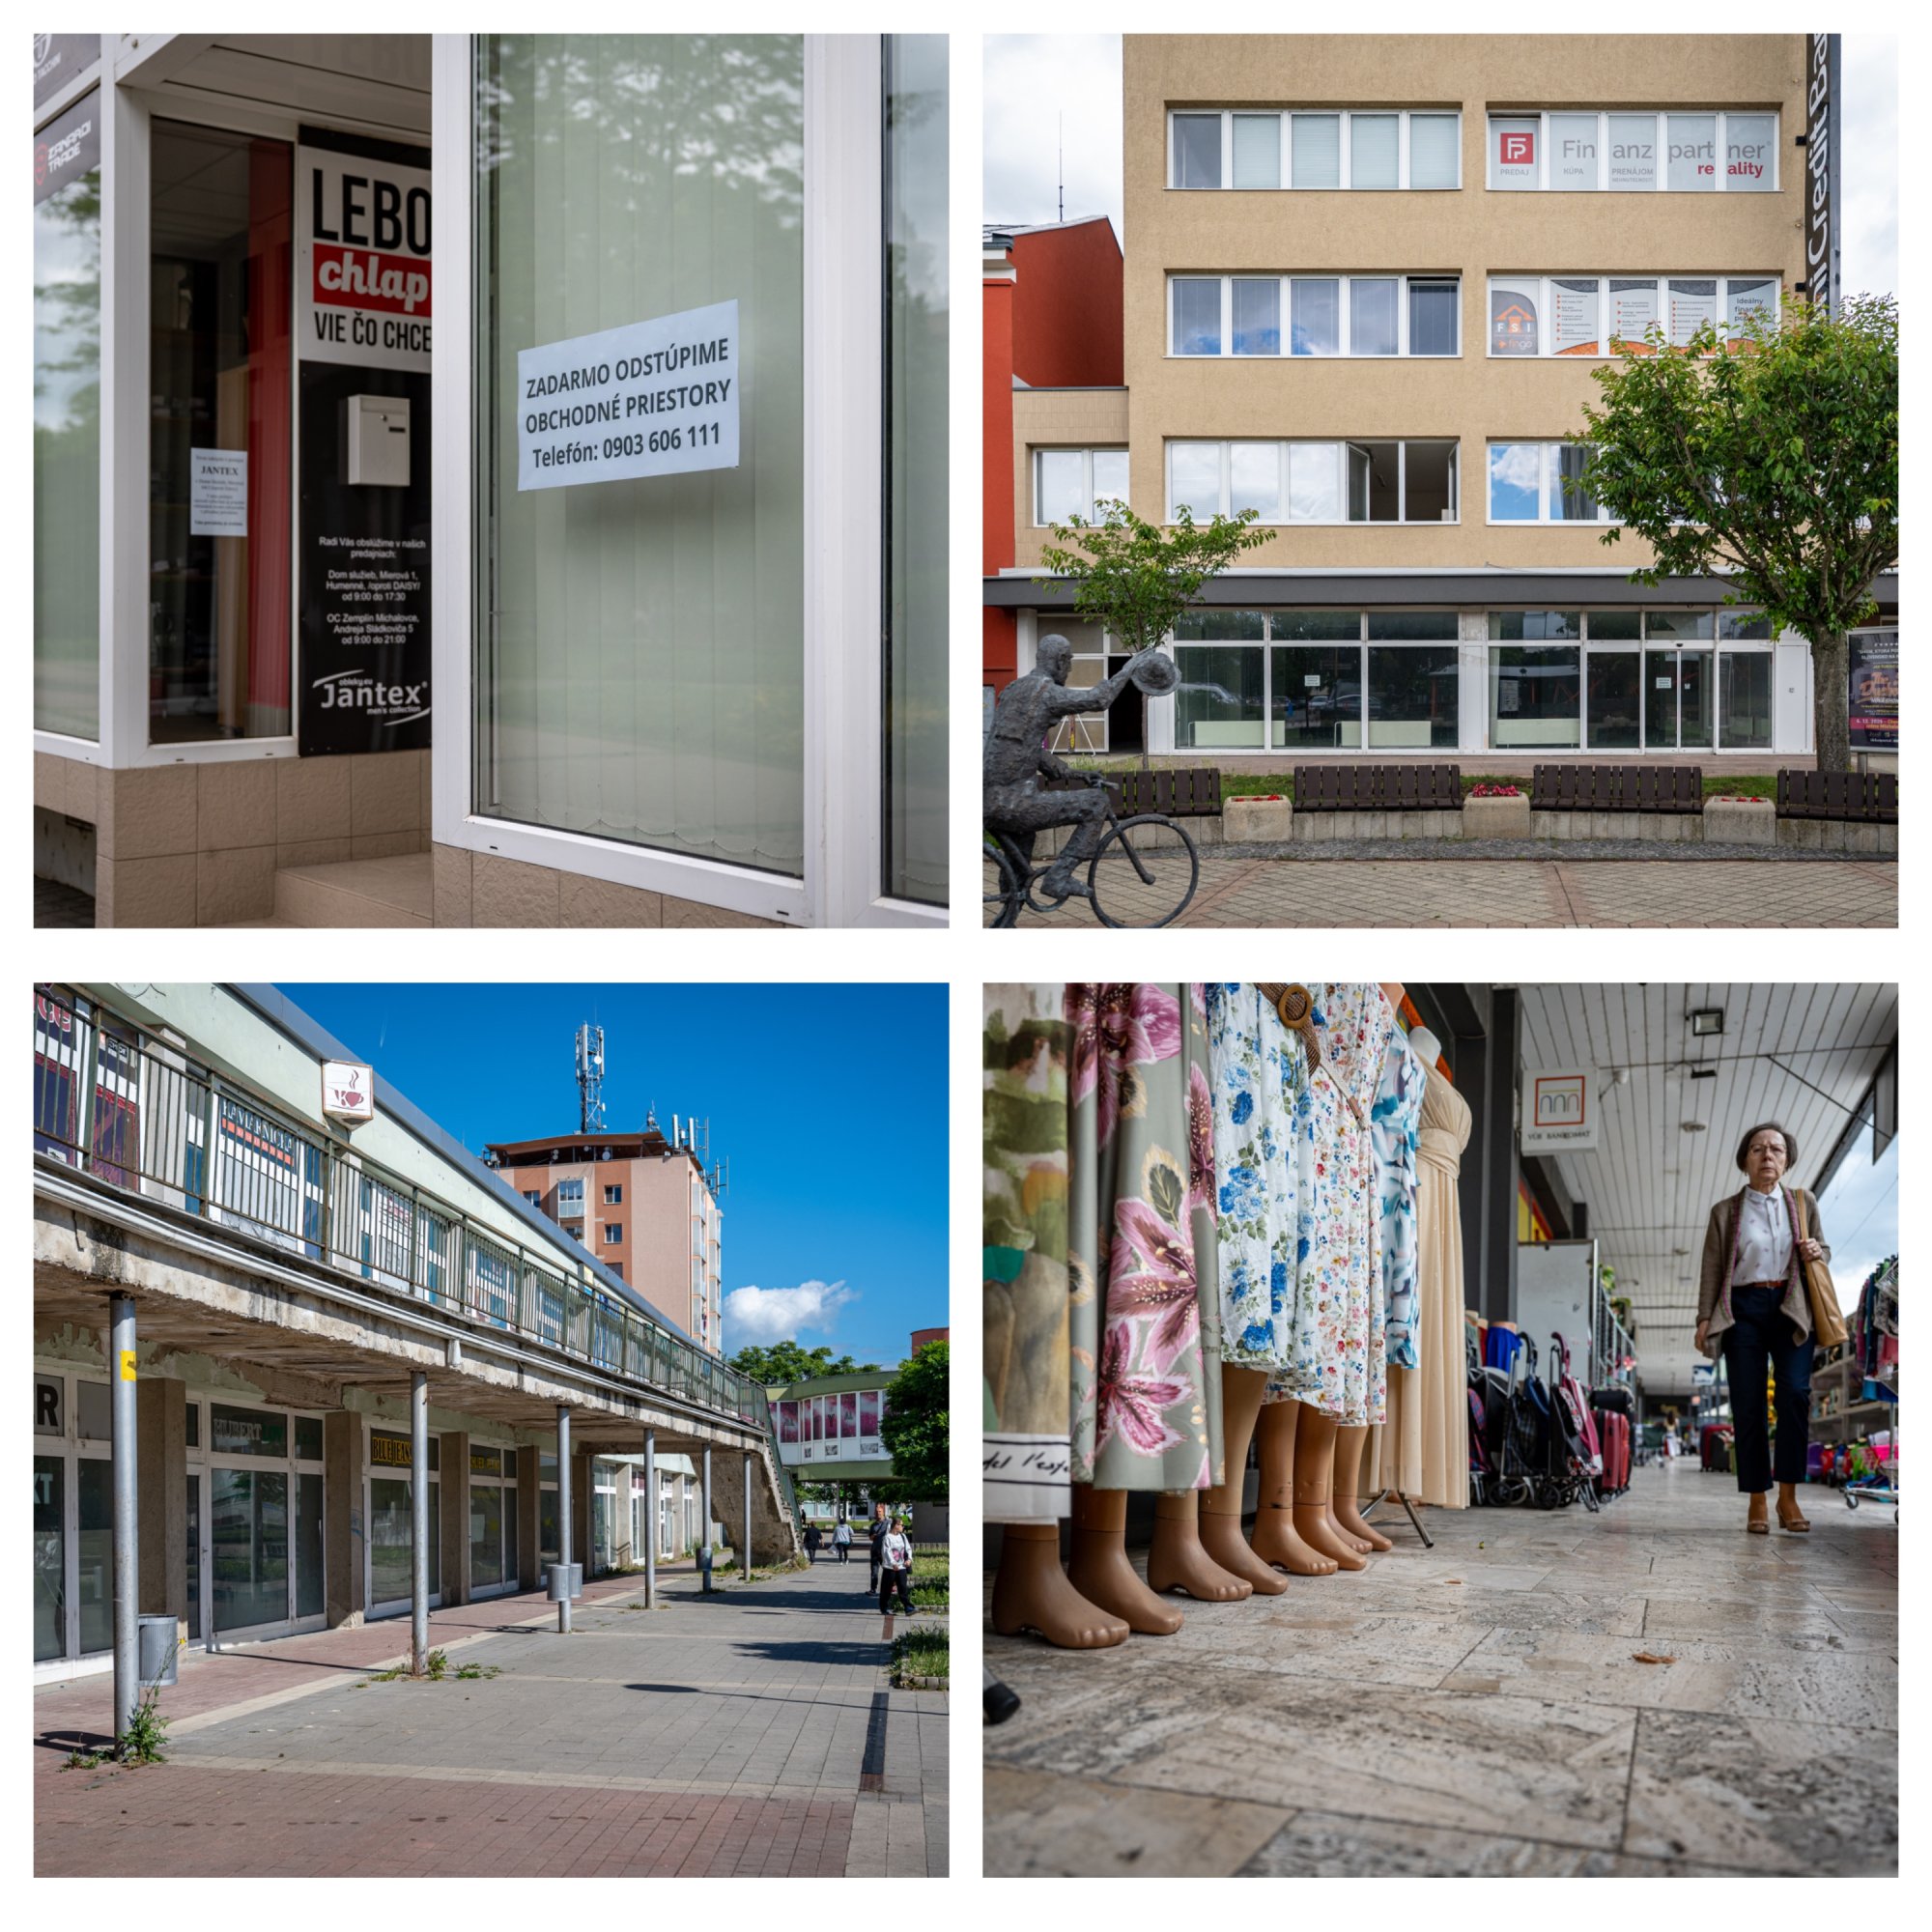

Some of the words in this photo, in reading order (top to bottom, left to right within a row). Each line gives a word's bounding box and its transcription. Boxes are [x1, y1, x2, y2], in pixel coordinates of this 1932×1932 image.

[48, 120, 92, 159] ZANARDI
[49, 142, 81, 173] TRADE
[1563, 166, 1584, 175] KÚPA
[1611, 166, 1654, 176] PRENÁJOM
[312, 167, 432, 256] LEBO
[318, 251, 429, 313] chlap
[314, 311, 347, 343] VIE
[353, 310, 377, 347] ČO
[384, 321, 432, 353] CHCE
[526, 363, 611, 399] ZADARMO
[615, 337, 729, 382] ODSTÚPIME
[526, 392, 620, 434] OBCHODNÉ
[626, 379, 731, 417] PRIESTORY
[533, 441, 598, 469] Telefón:
[603, 433, 644, 459] 0903
[649, 427, 681, 453] 606
[687, 422, 720, 448] 111
[201, 466, 239, 476] JANTEX
[319, 536, 338, 546] Radi
[339, 536, 355, 547] Vás
[402, 538, 426, 549] našich
[327, 570, 348, 580] Dom
[380, 570, 410, 580] Mierová
[342, 592, 353, 601] od
[354, 592, 371, 601] 9:00
[373, 592, 384, 601] do
[384, 592, 406, 601] 17:30
[327, 613, 341, 623] OC
[333, 625, 364, 635] Andreja
[408, 624, 413, 633] 5
[341, 636, 353, 644] od
[354, 635, 371, 644] 9:00
[373, 635, 384, 644] do
[384, 635, 406, 644] 21:00
[1547, 1130, 1591, 1139] BANKOMAT
[213, 1418, 263, 1440] HUBERT
[372, 1436, 391, 1463] BLUE
